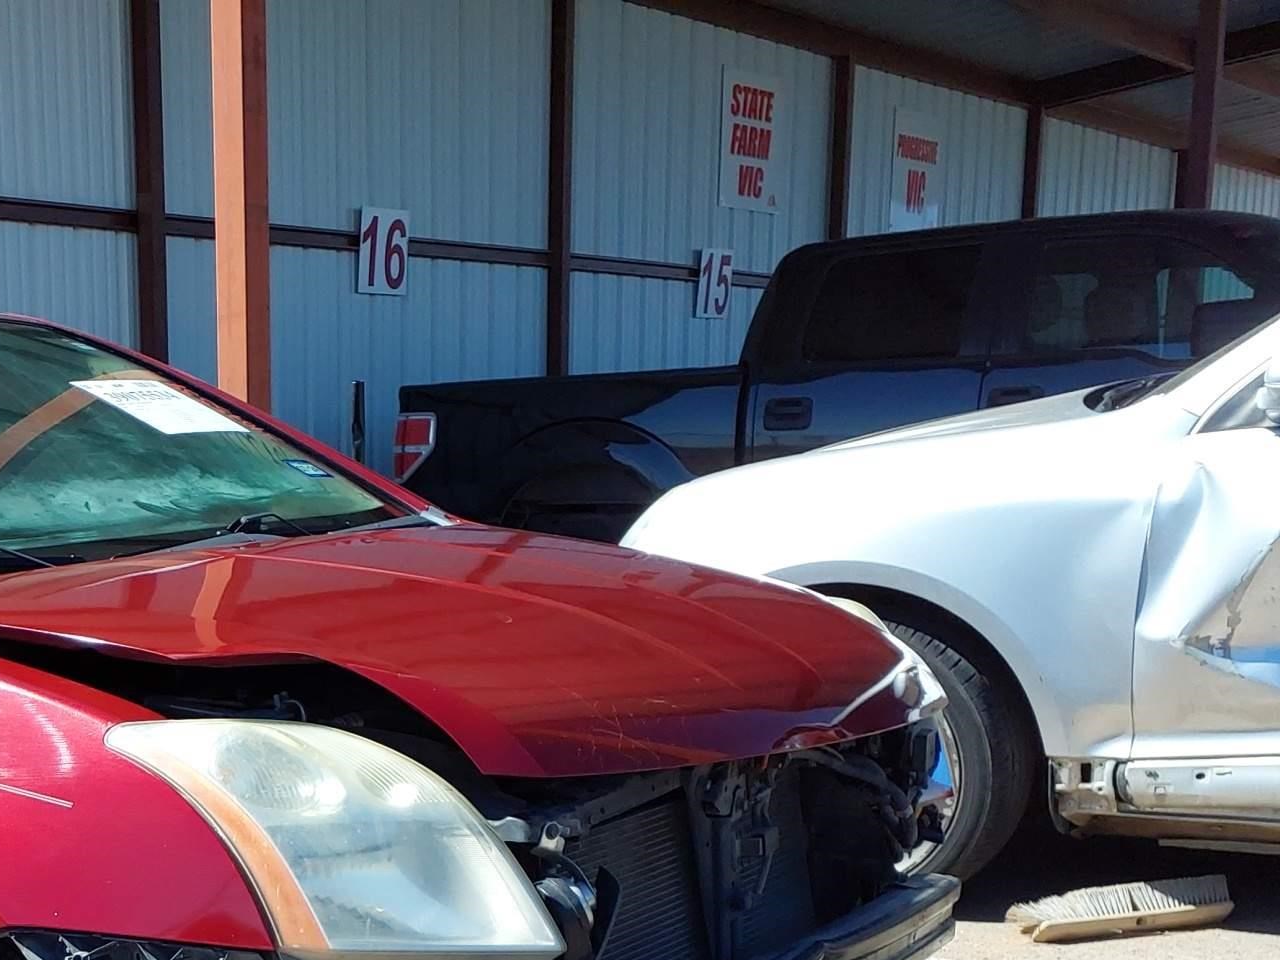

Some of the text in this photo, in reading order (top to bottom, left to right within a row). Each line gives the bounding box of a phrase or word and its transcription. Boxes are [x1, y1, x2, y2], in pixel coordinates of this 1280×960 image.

[730, 83, 775, 123] STATE
[730, 122, 772, 160] FARM
[738, 164, 765, 199] VIC
[906, 169, 926, 214] VIC
[361, 215, 406, 290] 16
[701, 253, 732, 315] 15
